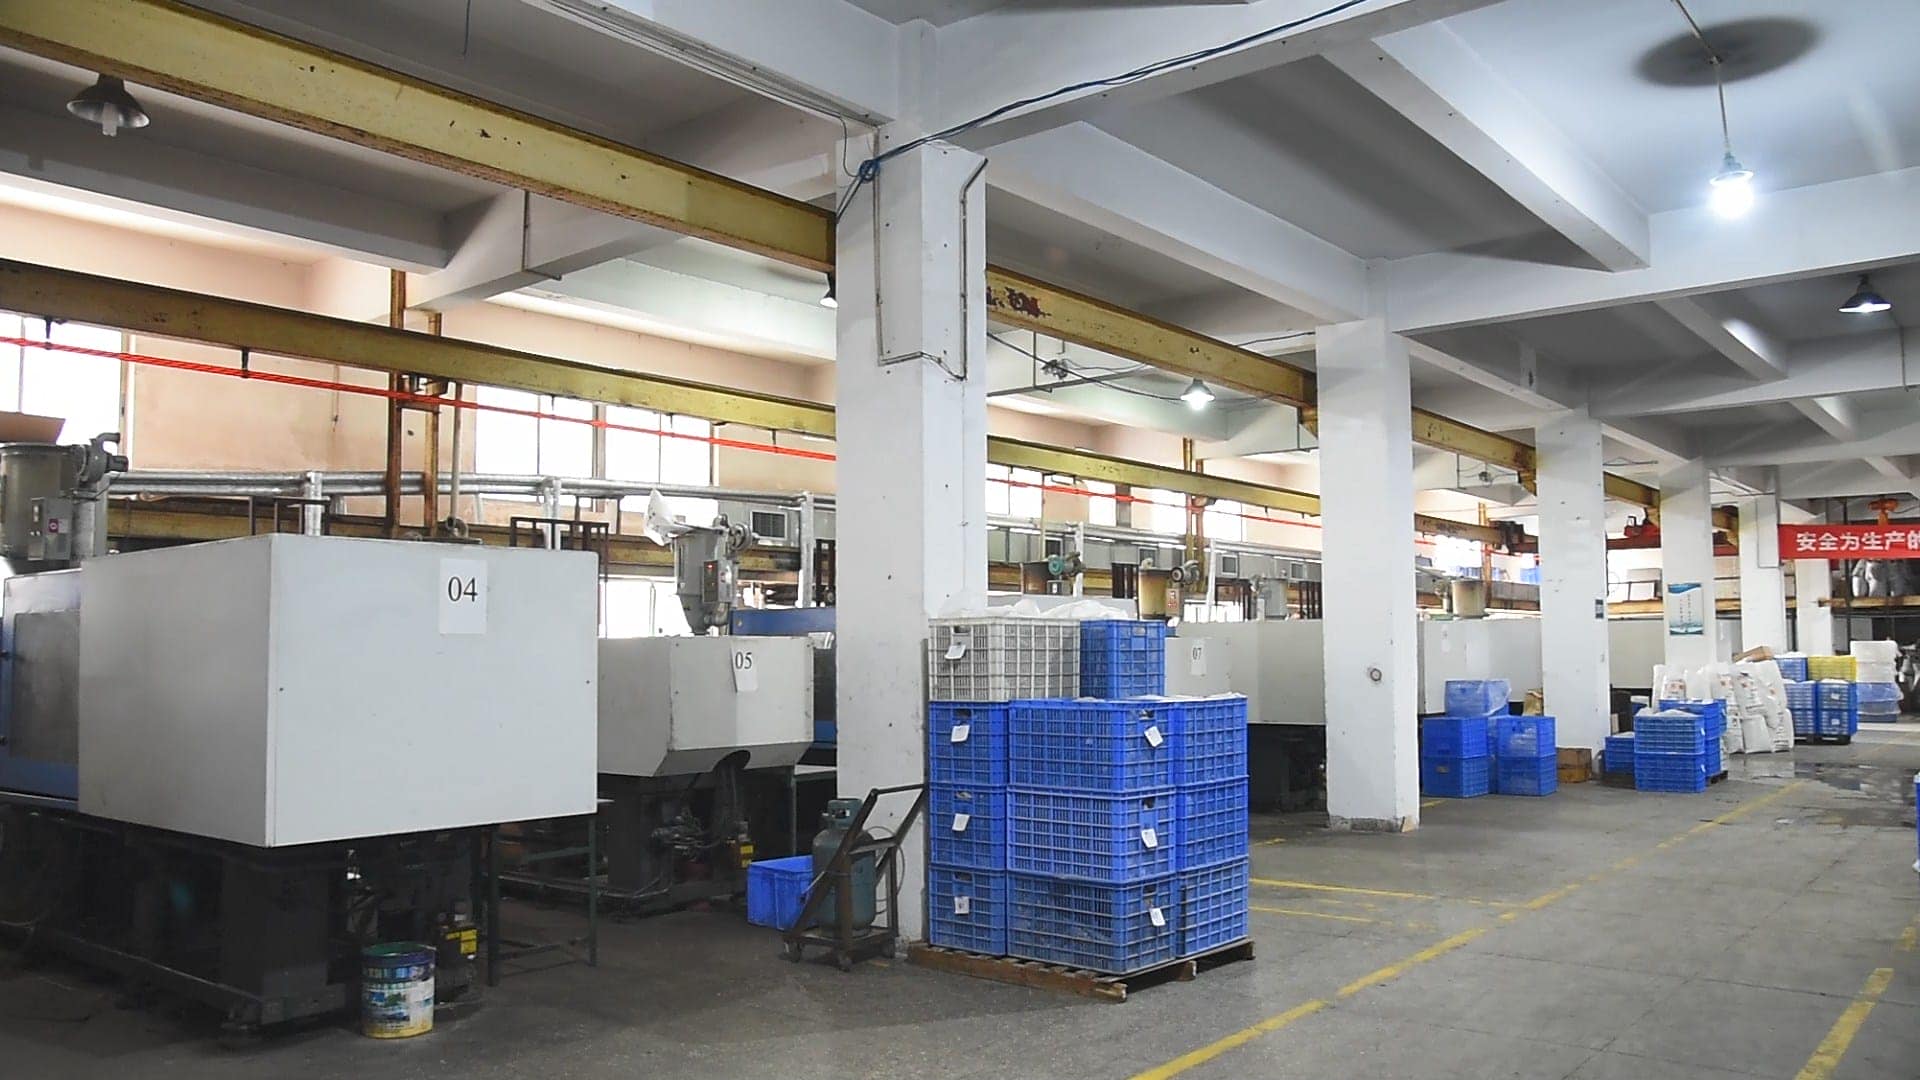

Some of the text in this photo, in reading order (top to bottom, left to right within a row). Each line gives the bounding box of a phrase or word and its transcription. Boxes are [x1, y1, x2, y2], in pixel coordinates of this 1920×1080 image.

[448, 576, 478, 602] 04
[735, 651, 752, 669] 05
[1192, 647, 1202, 660] 07
